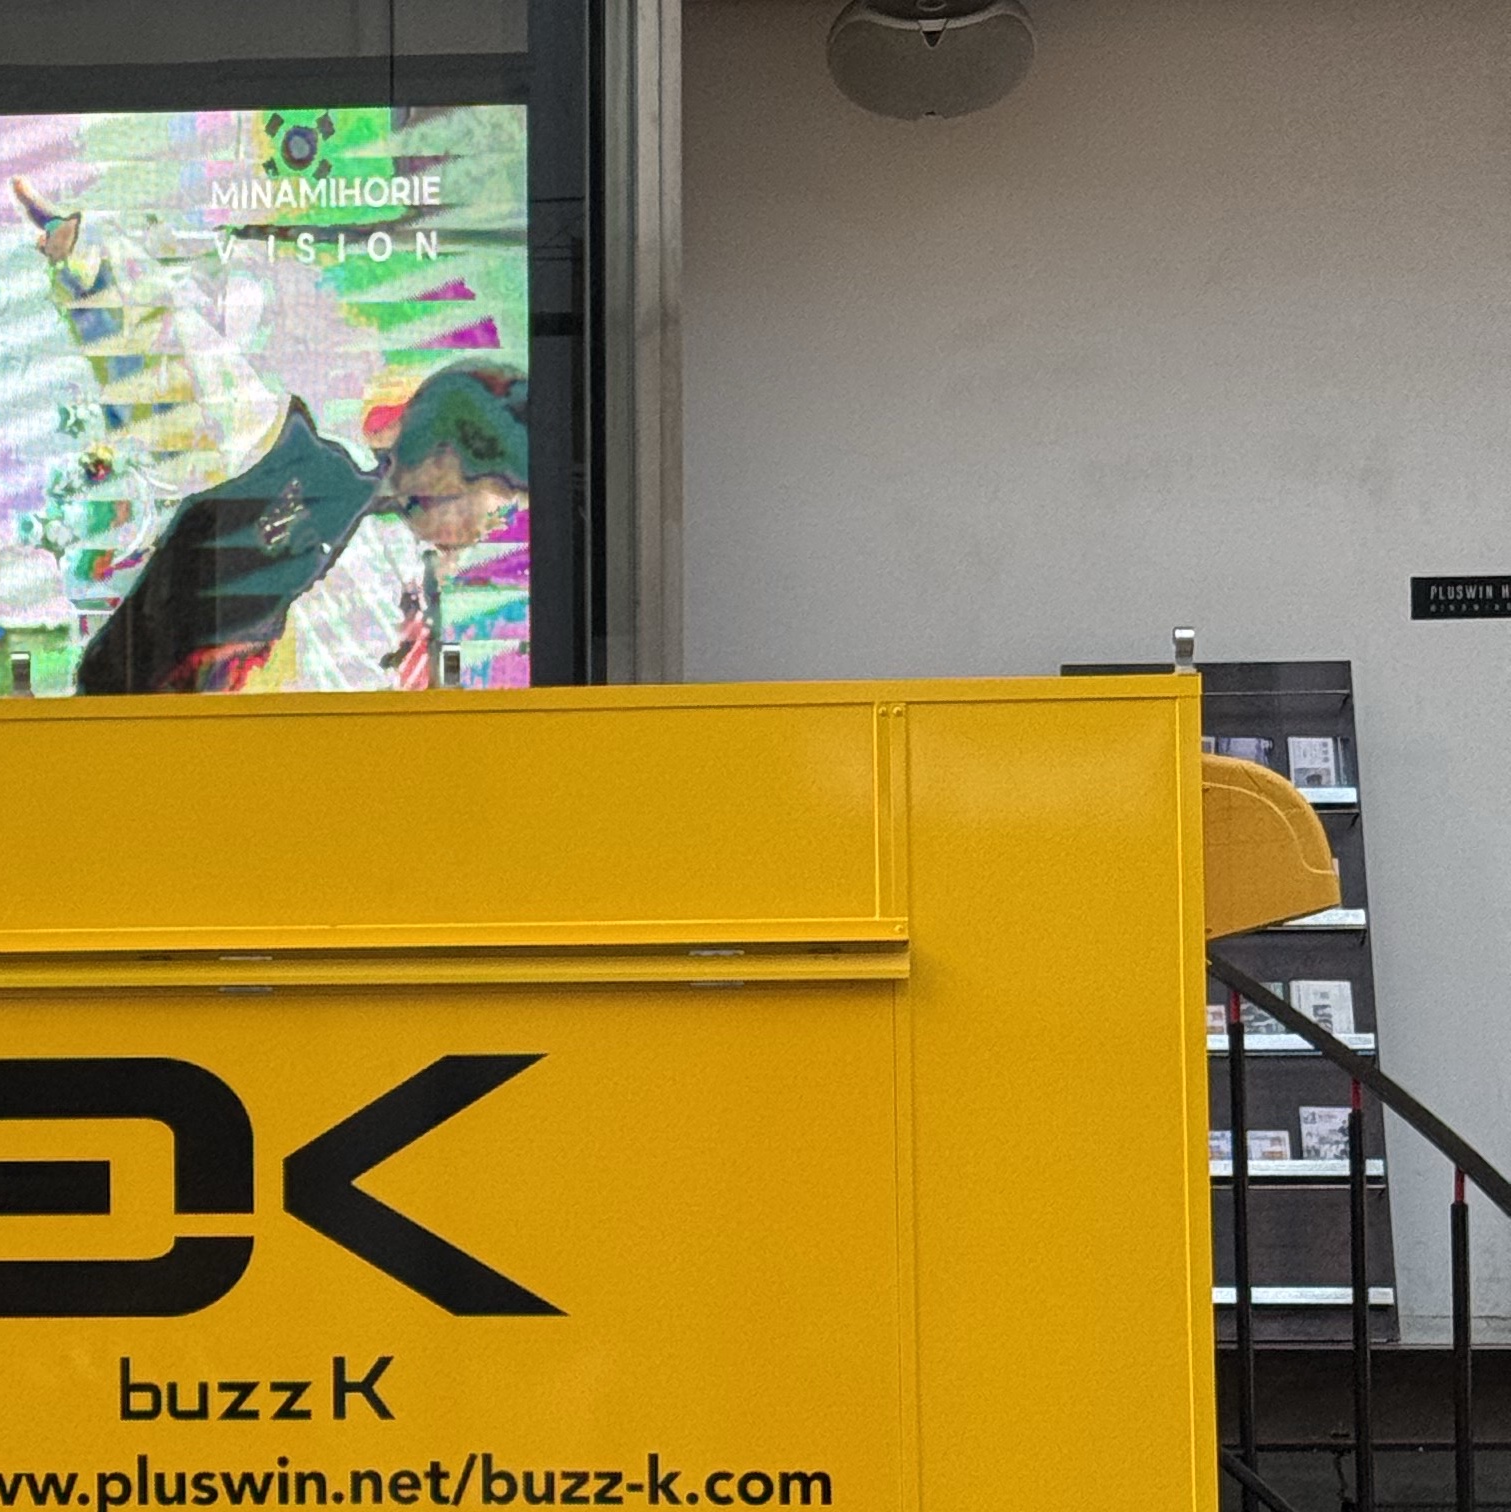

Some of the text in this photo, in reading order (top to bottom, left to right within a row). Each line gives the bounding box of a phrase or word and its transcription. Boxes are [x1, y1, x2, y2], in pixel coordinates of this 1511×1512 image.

[210, 175, 442, 210] MINAMIHORIE
[214, 230, 439, 265] VISION
[1429, 584, 1494, 601] PLUSWIN
[119, 1355, 396, 1421] buzz K
